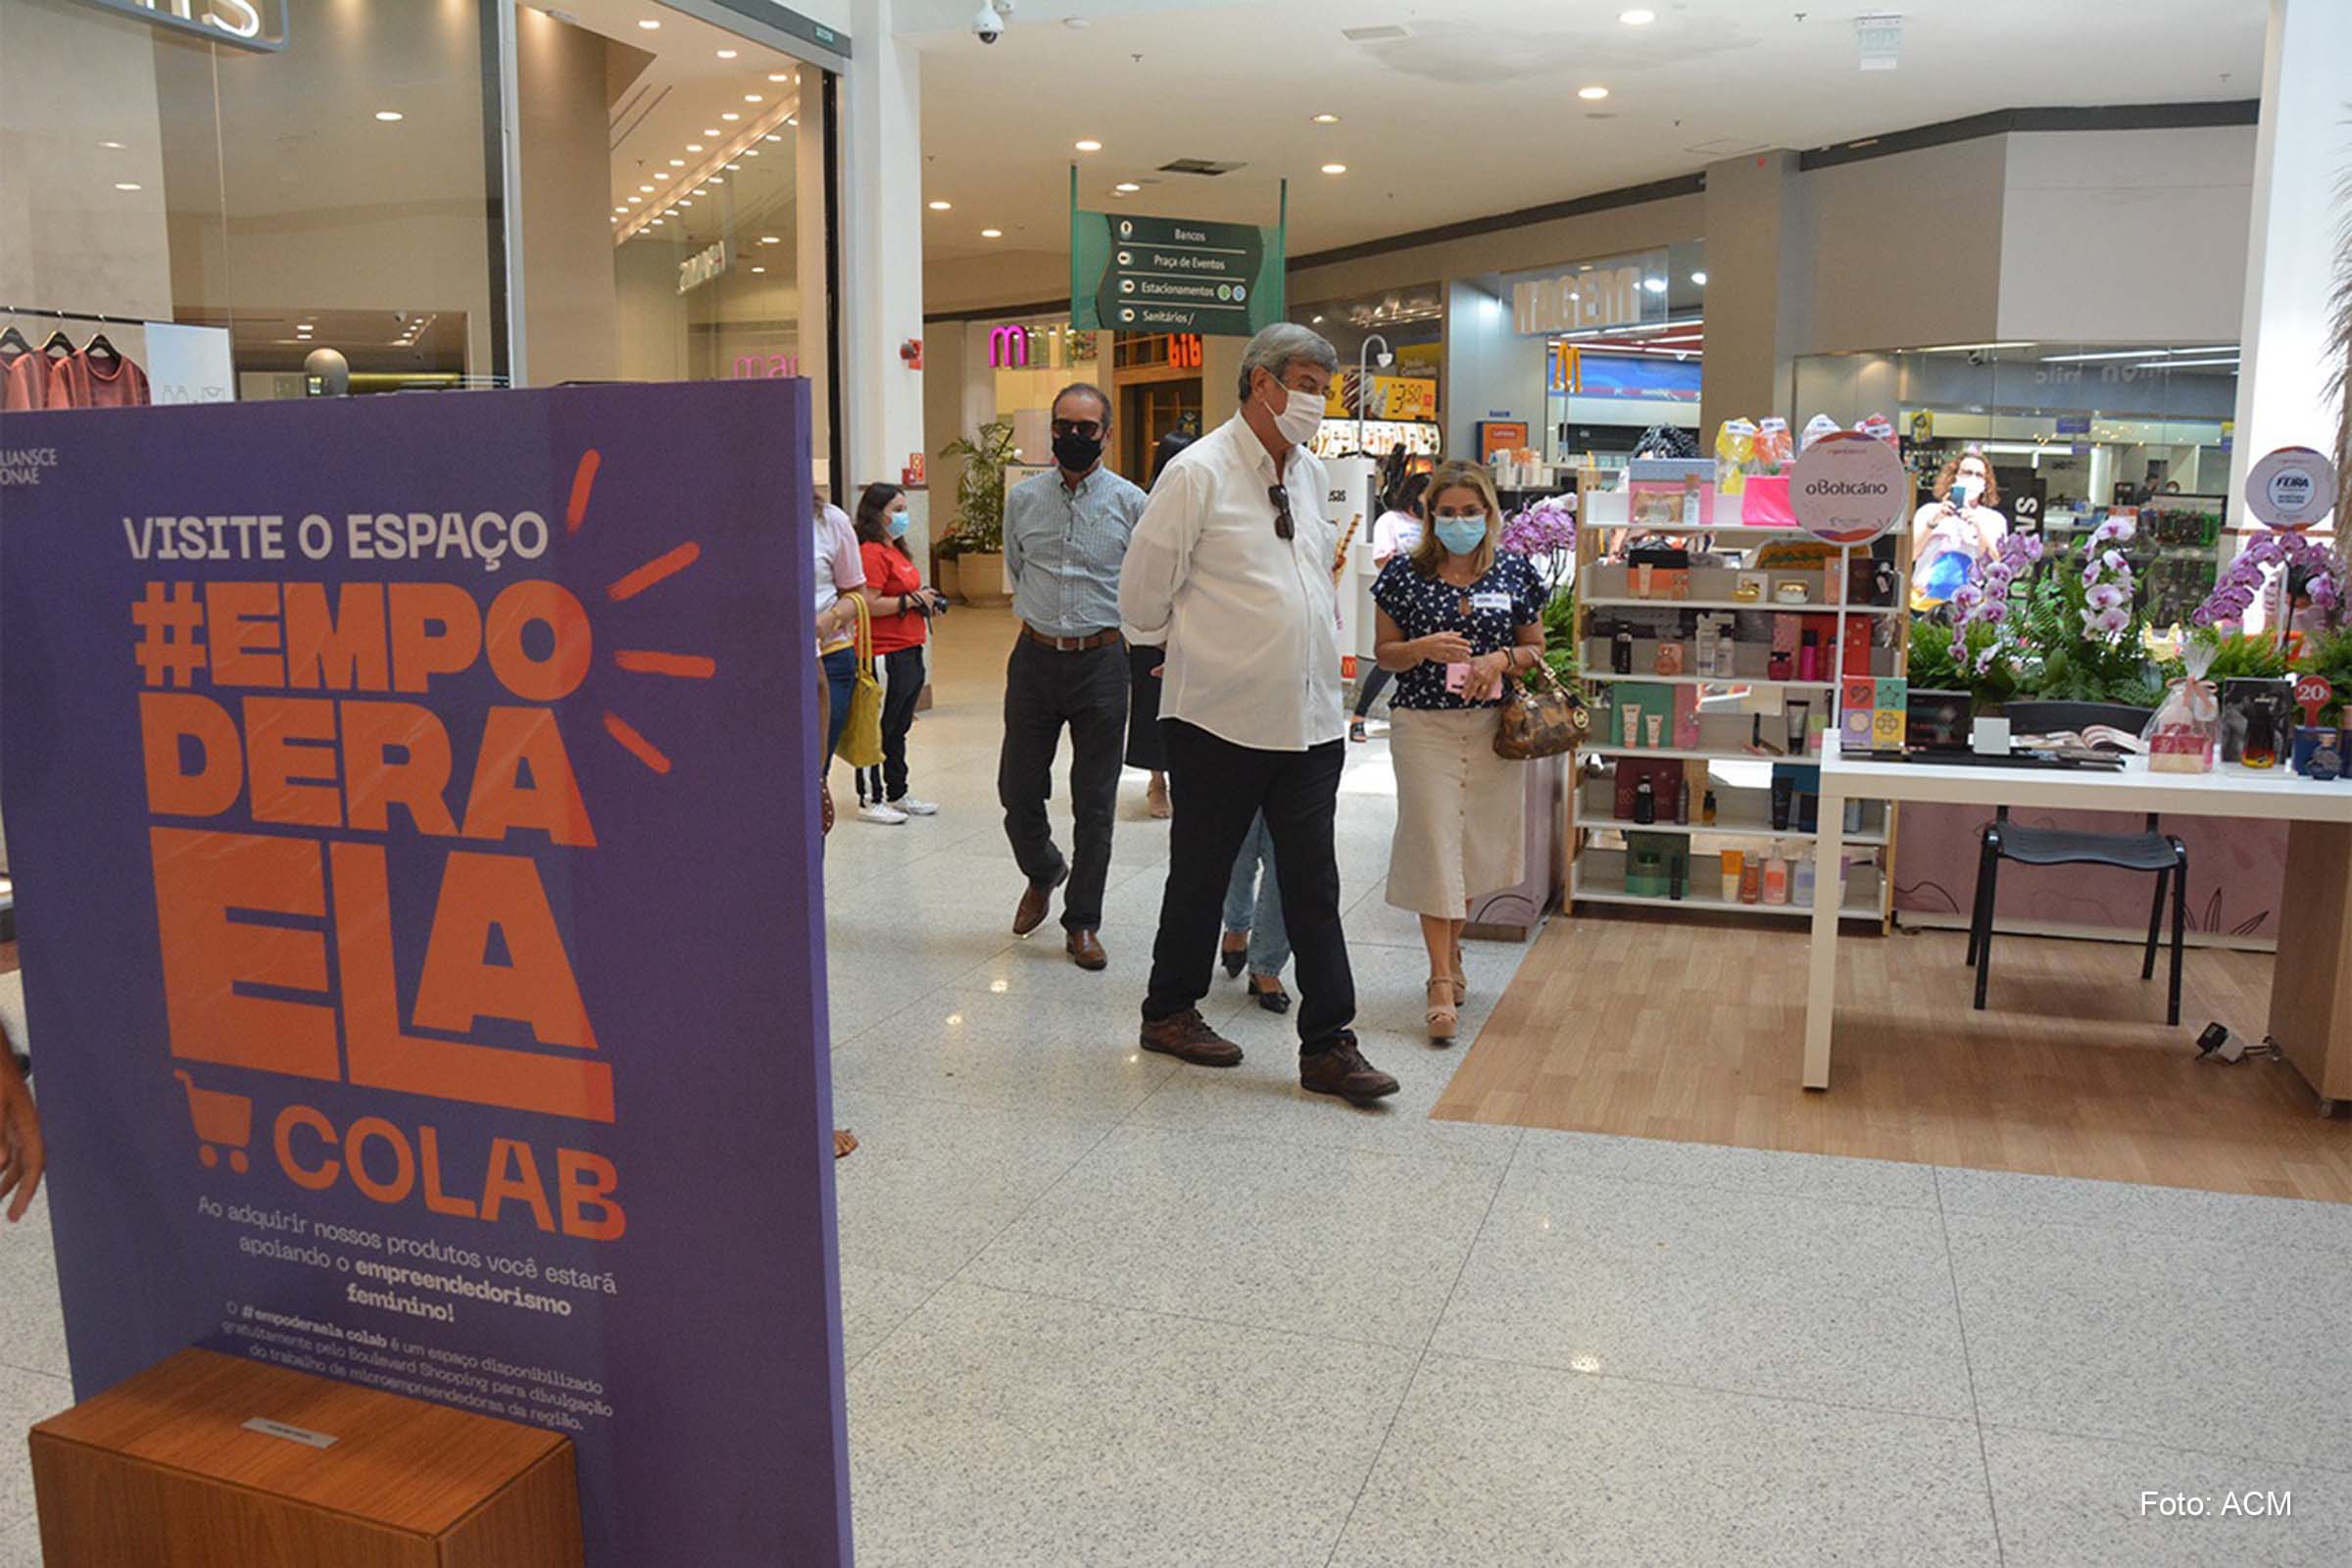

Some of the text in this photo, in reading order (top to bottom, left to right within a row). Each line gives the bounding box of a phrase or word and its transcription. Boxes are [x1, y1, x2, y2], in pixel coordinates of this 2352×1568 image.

[1153, 255, 1225, 270] Praça de Eventos
[1174, 228, 1206, 242] Bancos
[1141, 282, 1214, 297] Estacionamentos
[123, 511, 548, 571] VISITE O ESPAÇO
[132, 579, 593, 701] #EMPO
[139, 692, 598, 848] DERA
[150, 826, 615, 1124] ELA
[273, 1104, 627, 1243] COLAB
[198, 1196, 616, 1295] Ao adquirir nossos produtos você estará
[239, 1236, 572, 1316] apoiando o empreendedorismo
[347, 1282, 456, 1322] feminino!
[221, 1320, 613, 1418] gratuitamente pelo Boulevard Shopping para divulgação
[241, 1304, 344, 1339] #empoderaela
[346, 1329, 387, 1348] colab
[403, 1342, 425, 1356] um
[427, 1347, 478, 1369] espaço
[481, 1357, 604, 1396] disponibilizado
[270, 1348, 327, 1372] trabalho
[328, 1360, 347, 1377] de
[508, 1401, 528, 1417] da
